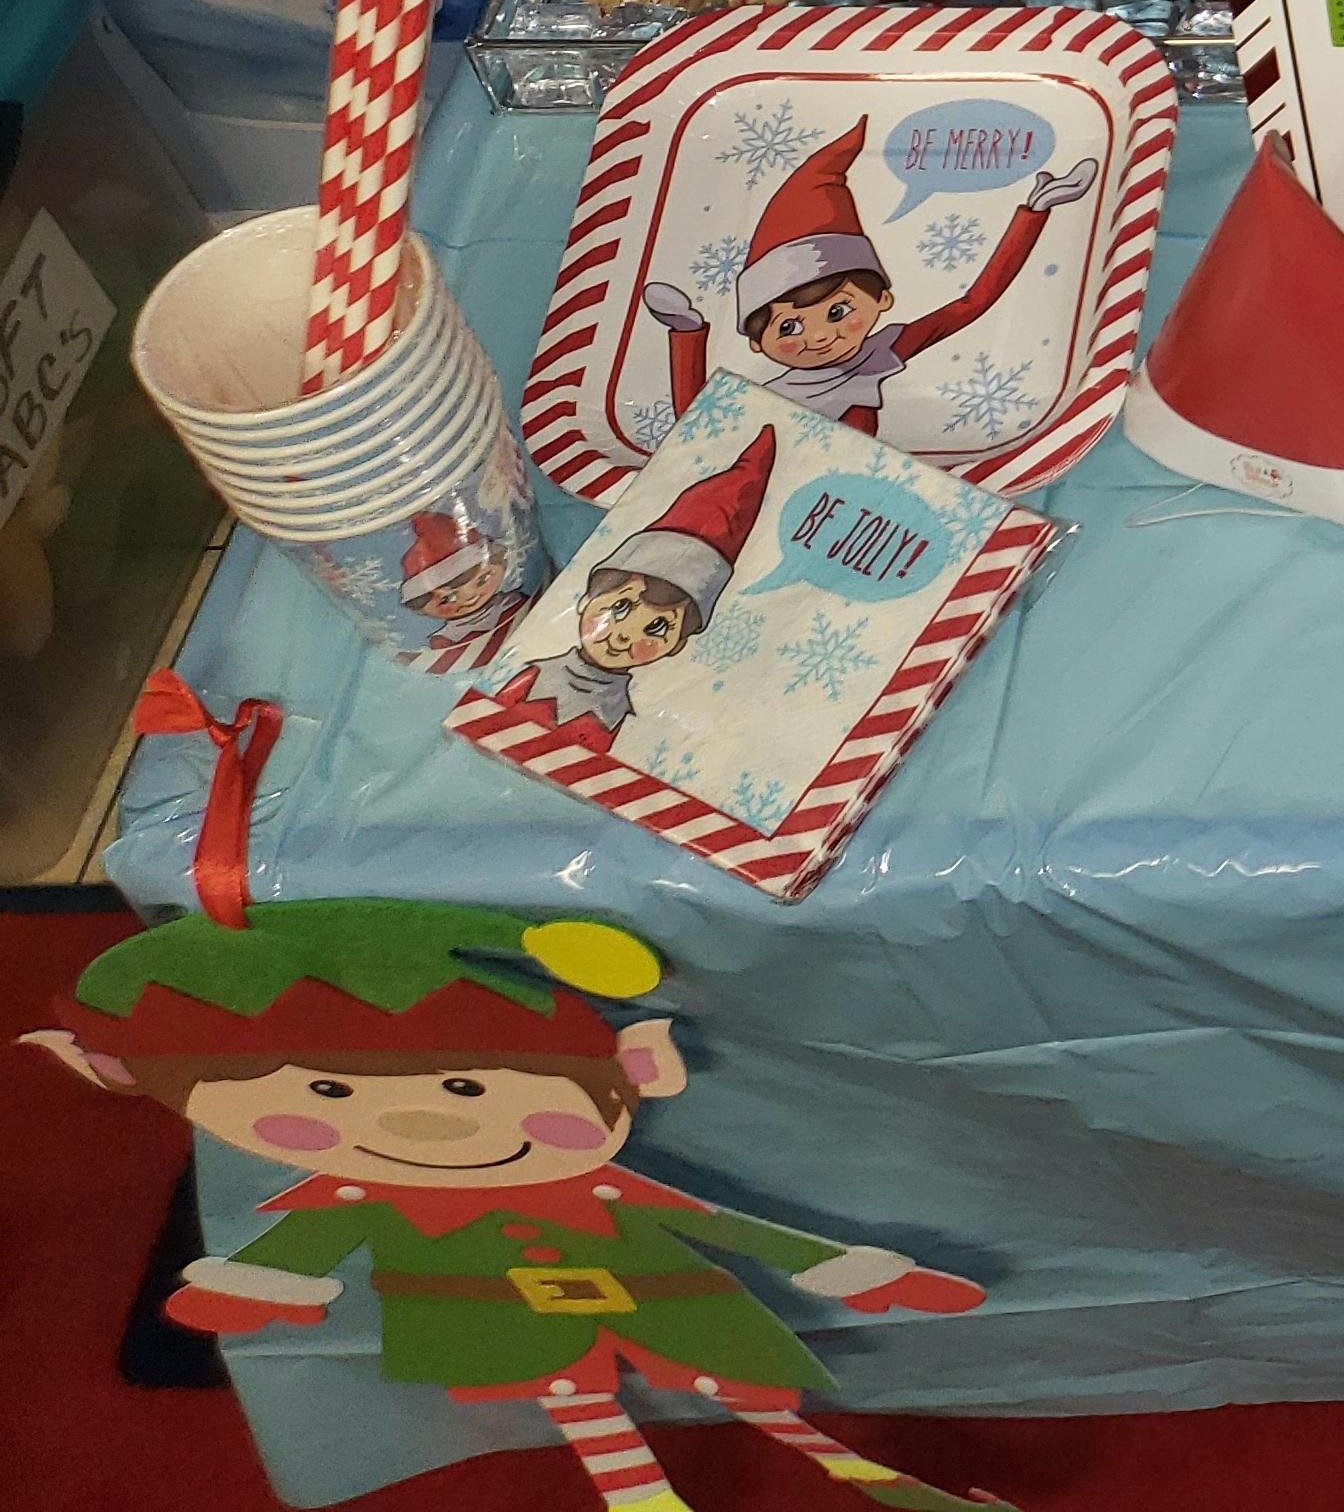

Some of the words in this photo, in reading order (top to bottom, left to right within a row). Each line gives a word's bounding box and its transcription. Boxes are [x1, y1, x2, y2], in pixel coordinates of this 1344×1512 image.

[904, 128, 938, 170] BE
[942, 128, 1033, 170] MERRY!
[790, 491, 846, 551] BE
[826, 507, 930, 582] JOLLY!
